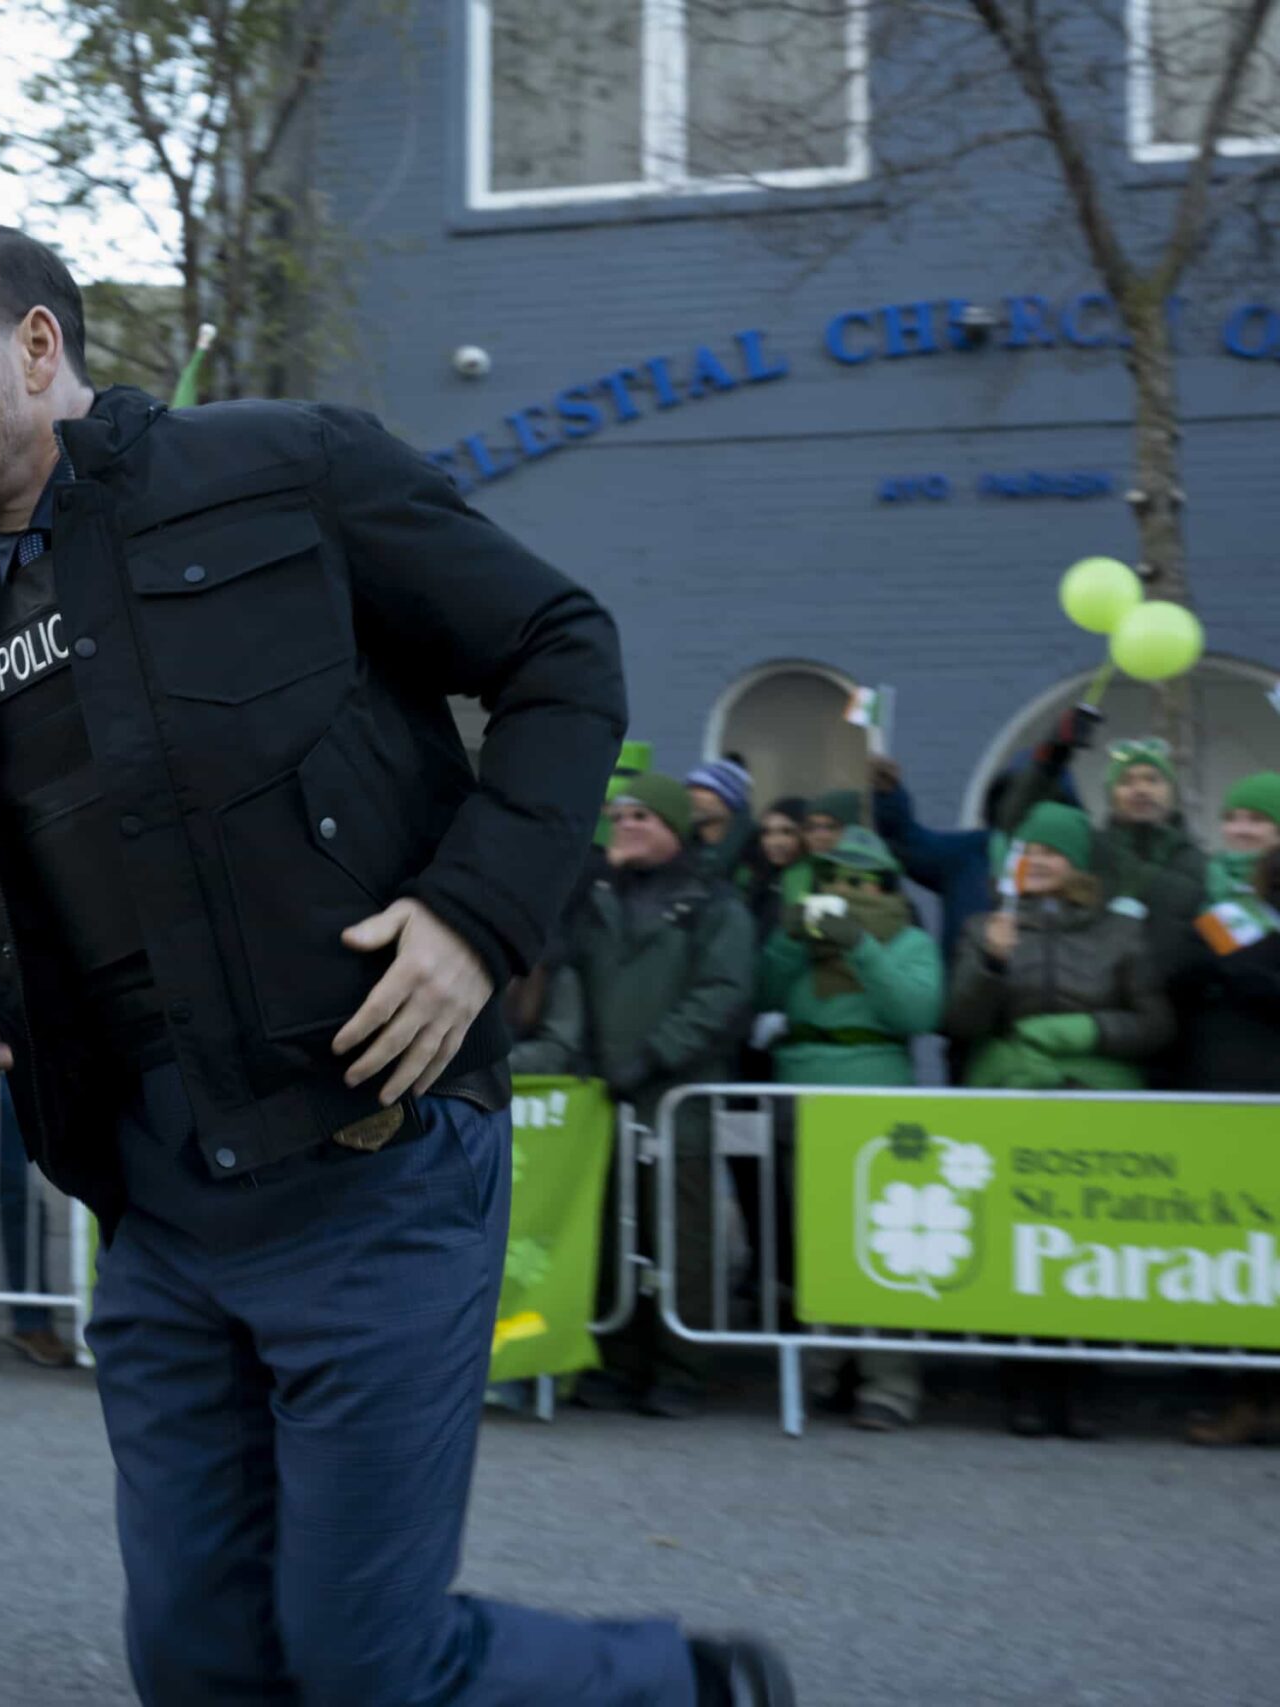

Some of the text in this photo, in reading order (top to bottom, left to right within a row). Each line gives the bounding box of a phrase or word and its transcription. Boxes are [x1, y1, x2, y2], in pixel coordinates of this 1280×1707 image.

[823, 293, 1190, 364] CHRC
[1222, 303, 1280, 360] O
[1012, 1147, 1178, 1178] BOSTON
[1011, 1222, 1280, 1306] Parad
